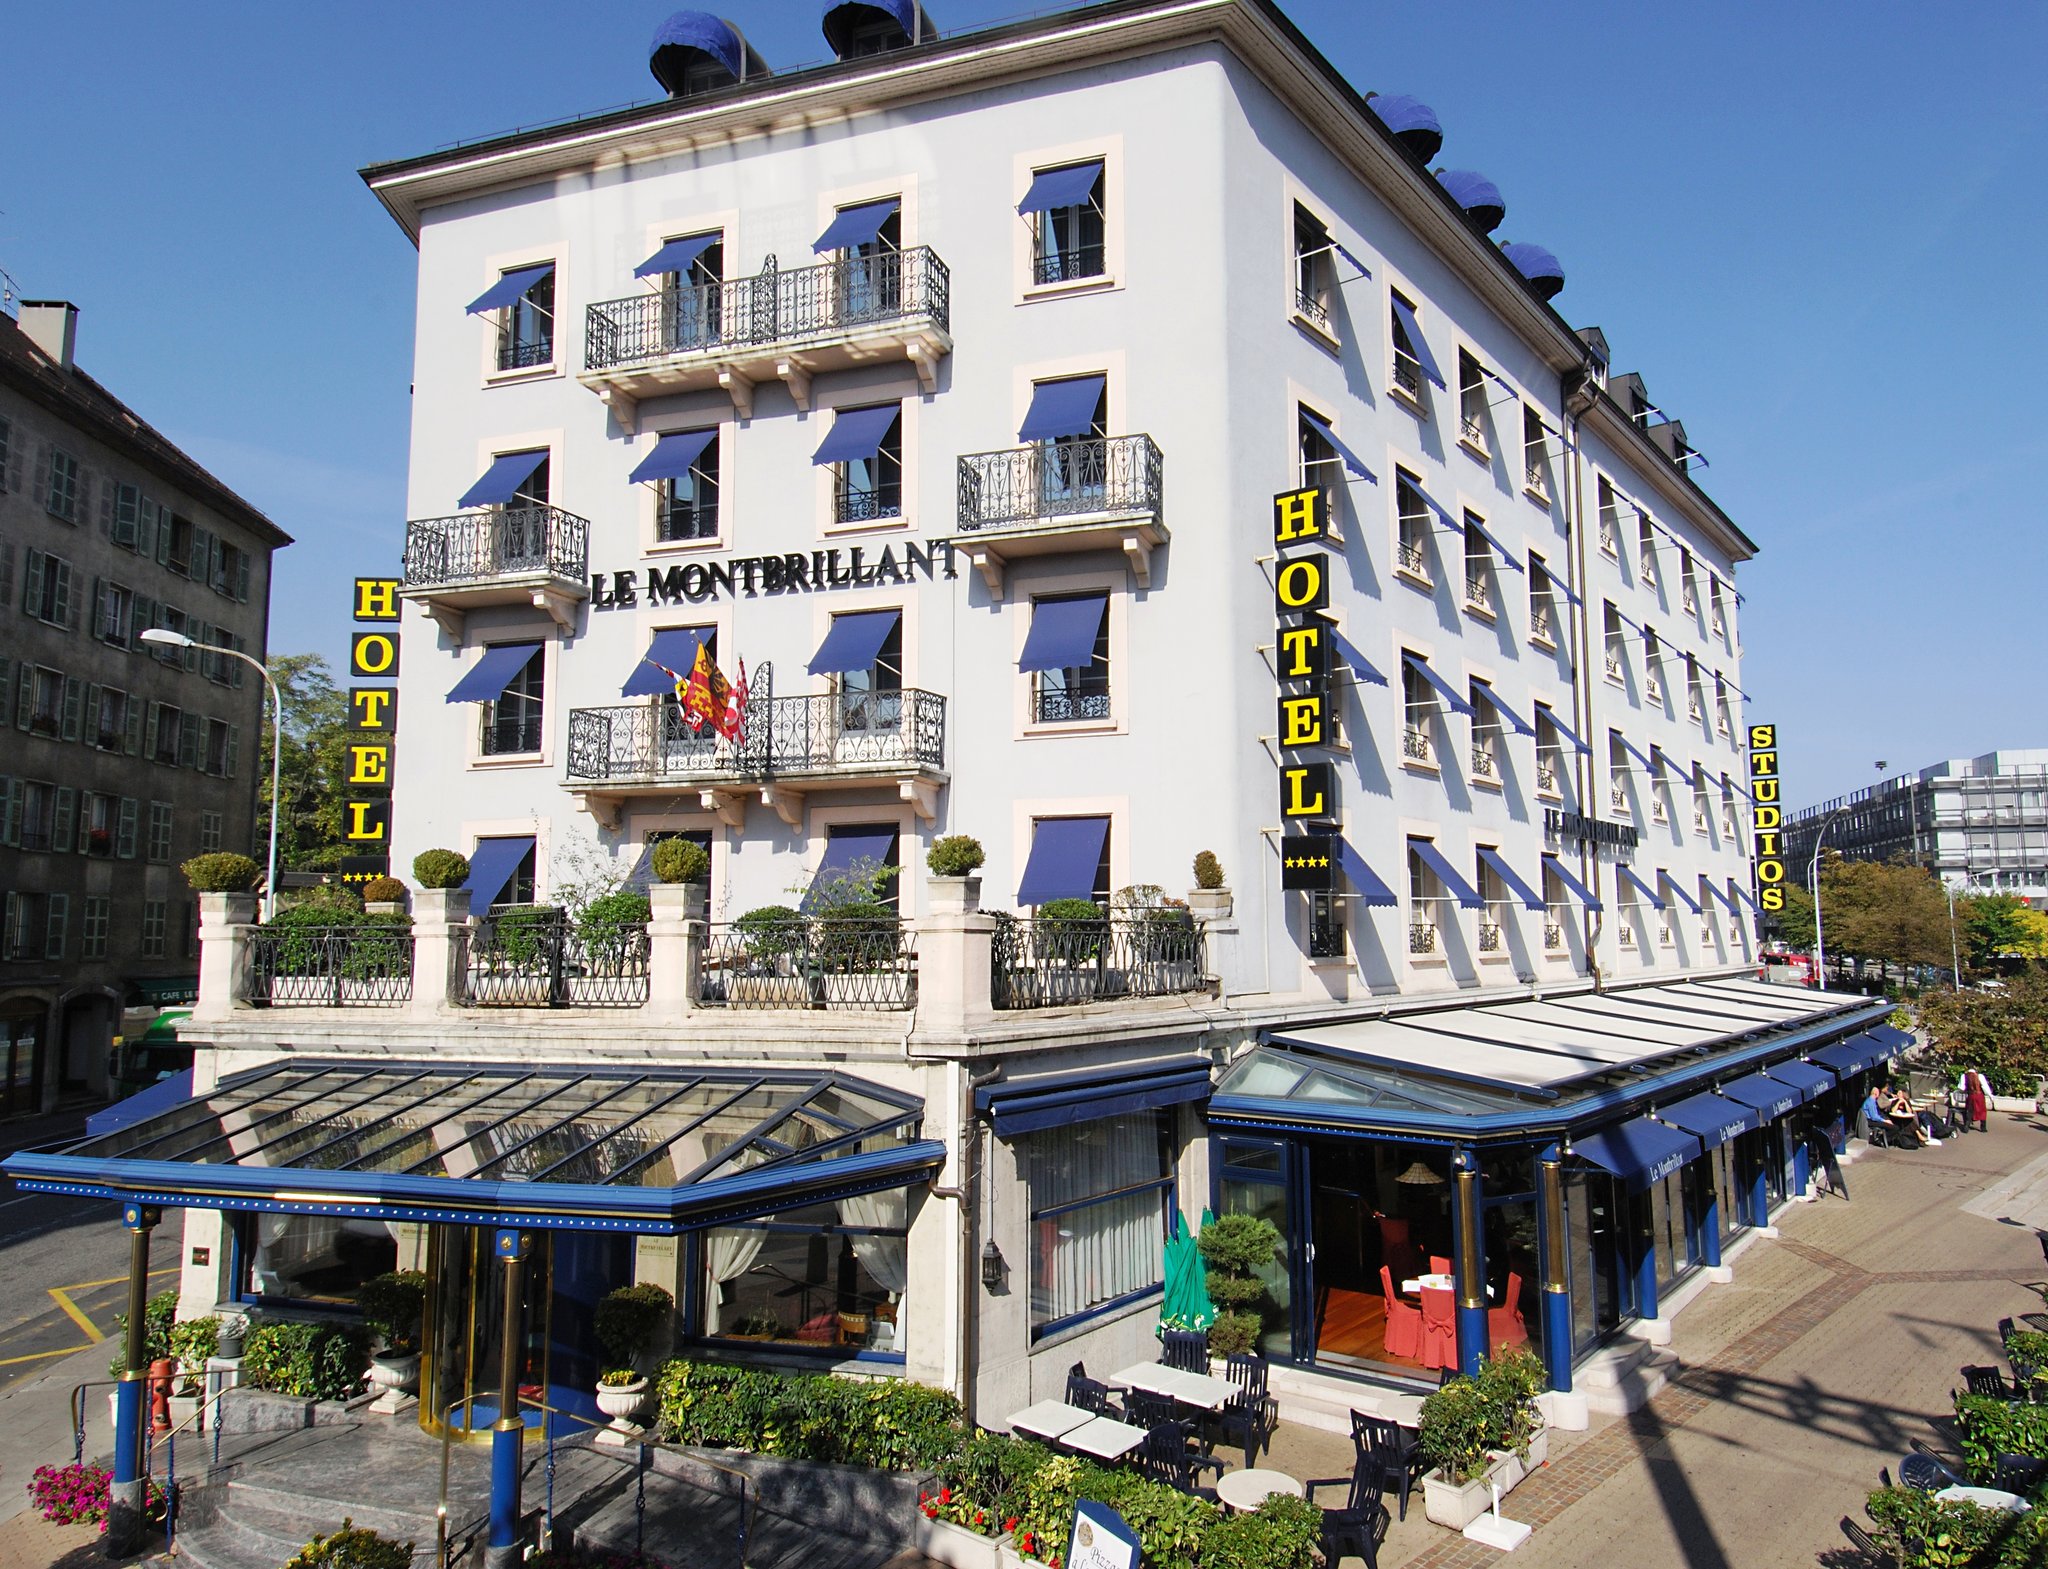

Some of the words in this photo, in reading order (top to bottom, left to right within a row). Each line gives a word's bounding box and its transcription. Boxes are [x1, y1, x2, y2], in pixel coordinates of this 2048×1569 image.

[590, 570, 637, 606] LE
[647, 539, 956, 600] MONTBRILLANT
[348, 580, 398, 840] HOTEL
[1276, 489, 1324, 816] HOTEL
[1751, 725, 1785, 911] STUDIOS
[1650, 1166, 1659, 1182] Le
[1720, 1128, 1727, 1142] Le
